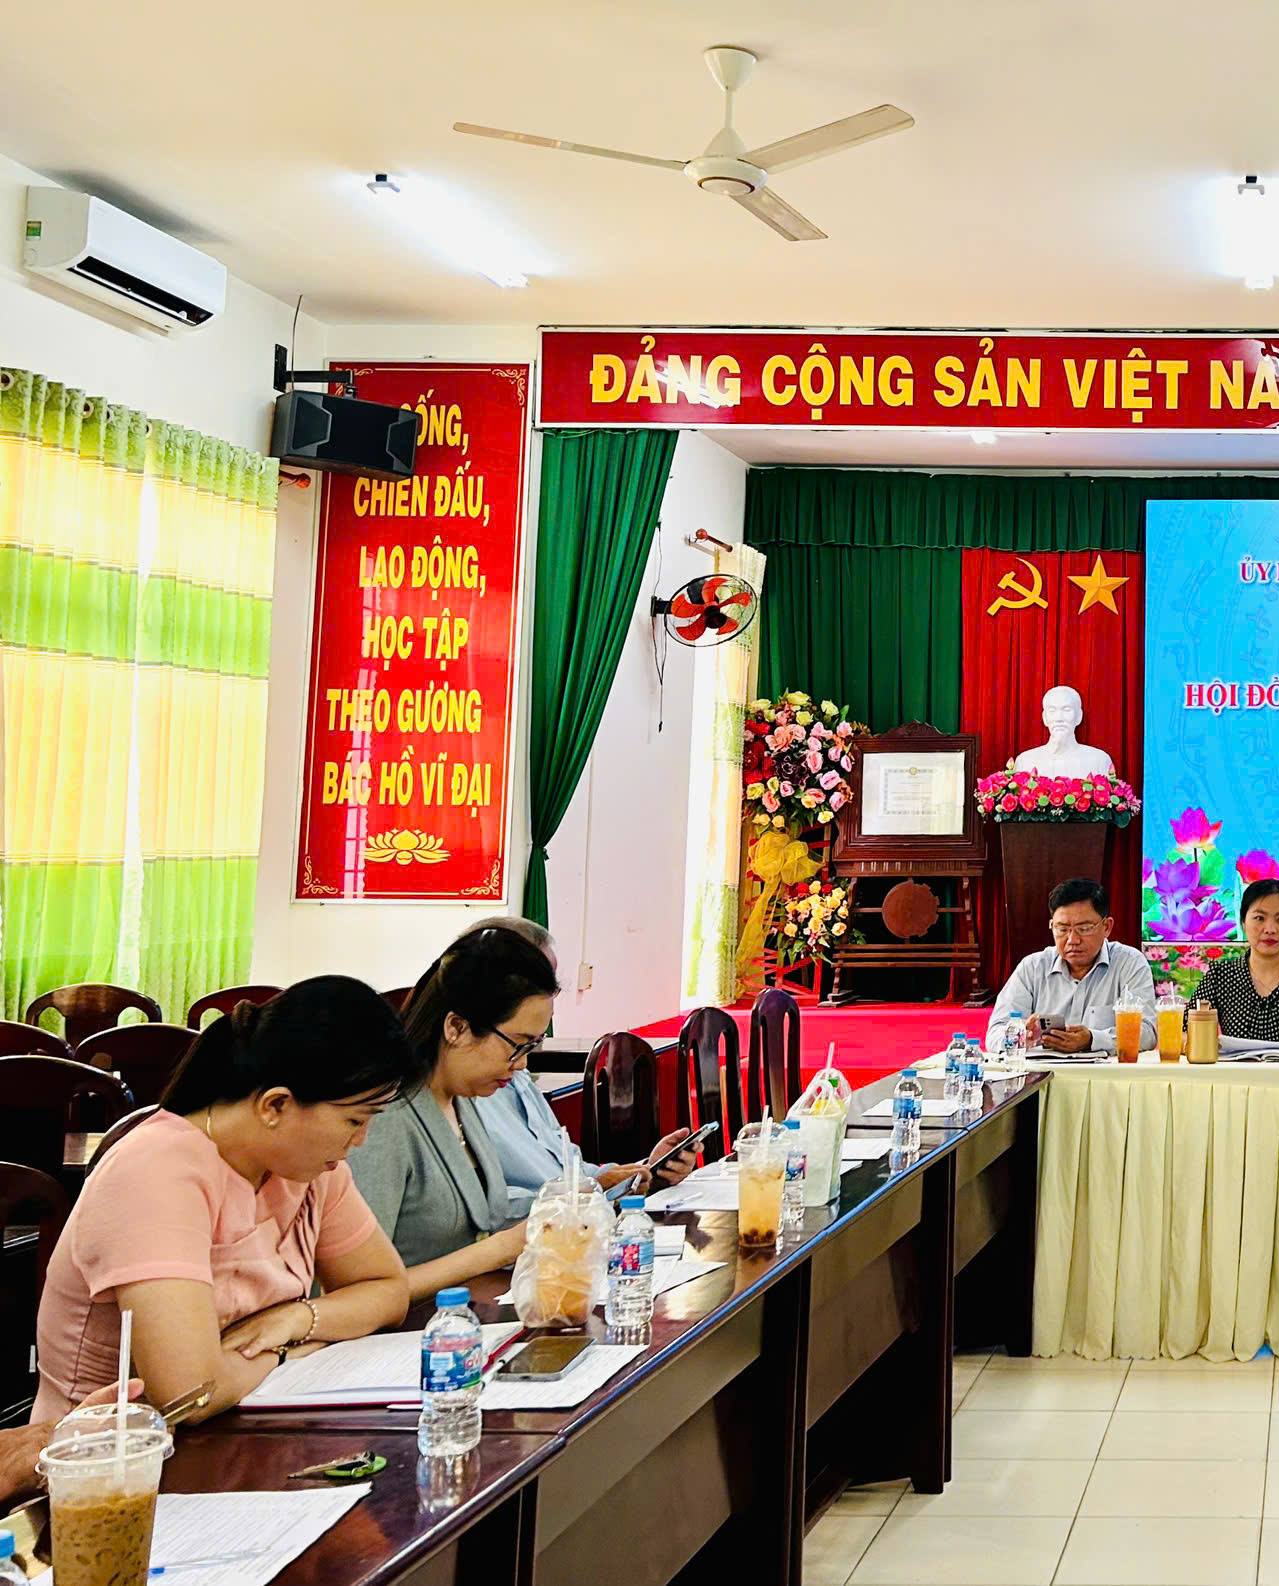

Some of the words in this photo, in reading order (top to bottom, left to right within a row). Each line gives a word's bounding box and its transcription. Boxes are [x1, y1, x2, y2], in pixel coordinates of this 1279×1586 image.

[590, 336, 741, 407] ĐẢNG
[763, 344, 914, 420] CỘNG
[934, 338, 1040, 409] SẢN
[1062, 347, 1189, 423] VIỆT
[434, 460, 490, 527] ĐẤU,
[359, 545, 405, 589] LAO
[411, 535, 486, 600] ĐỘNG,
[1240, 556, 1271, 582] ỦY
[362, 616, 414, 671] HỌC
[423, 607, 469, 671] TẬP
[326, 688, 391, 732] THEO
[397, 680, 482, 733] GƯƠNG
[1184, 680, 1238, 714] HỘI
[322, 751, 372, 805] BÁC
[379, 745, 414, 806] HỒ
[421, 752, 448, 806] VĨ
[451, 763, 491, 818] ĐẠI
